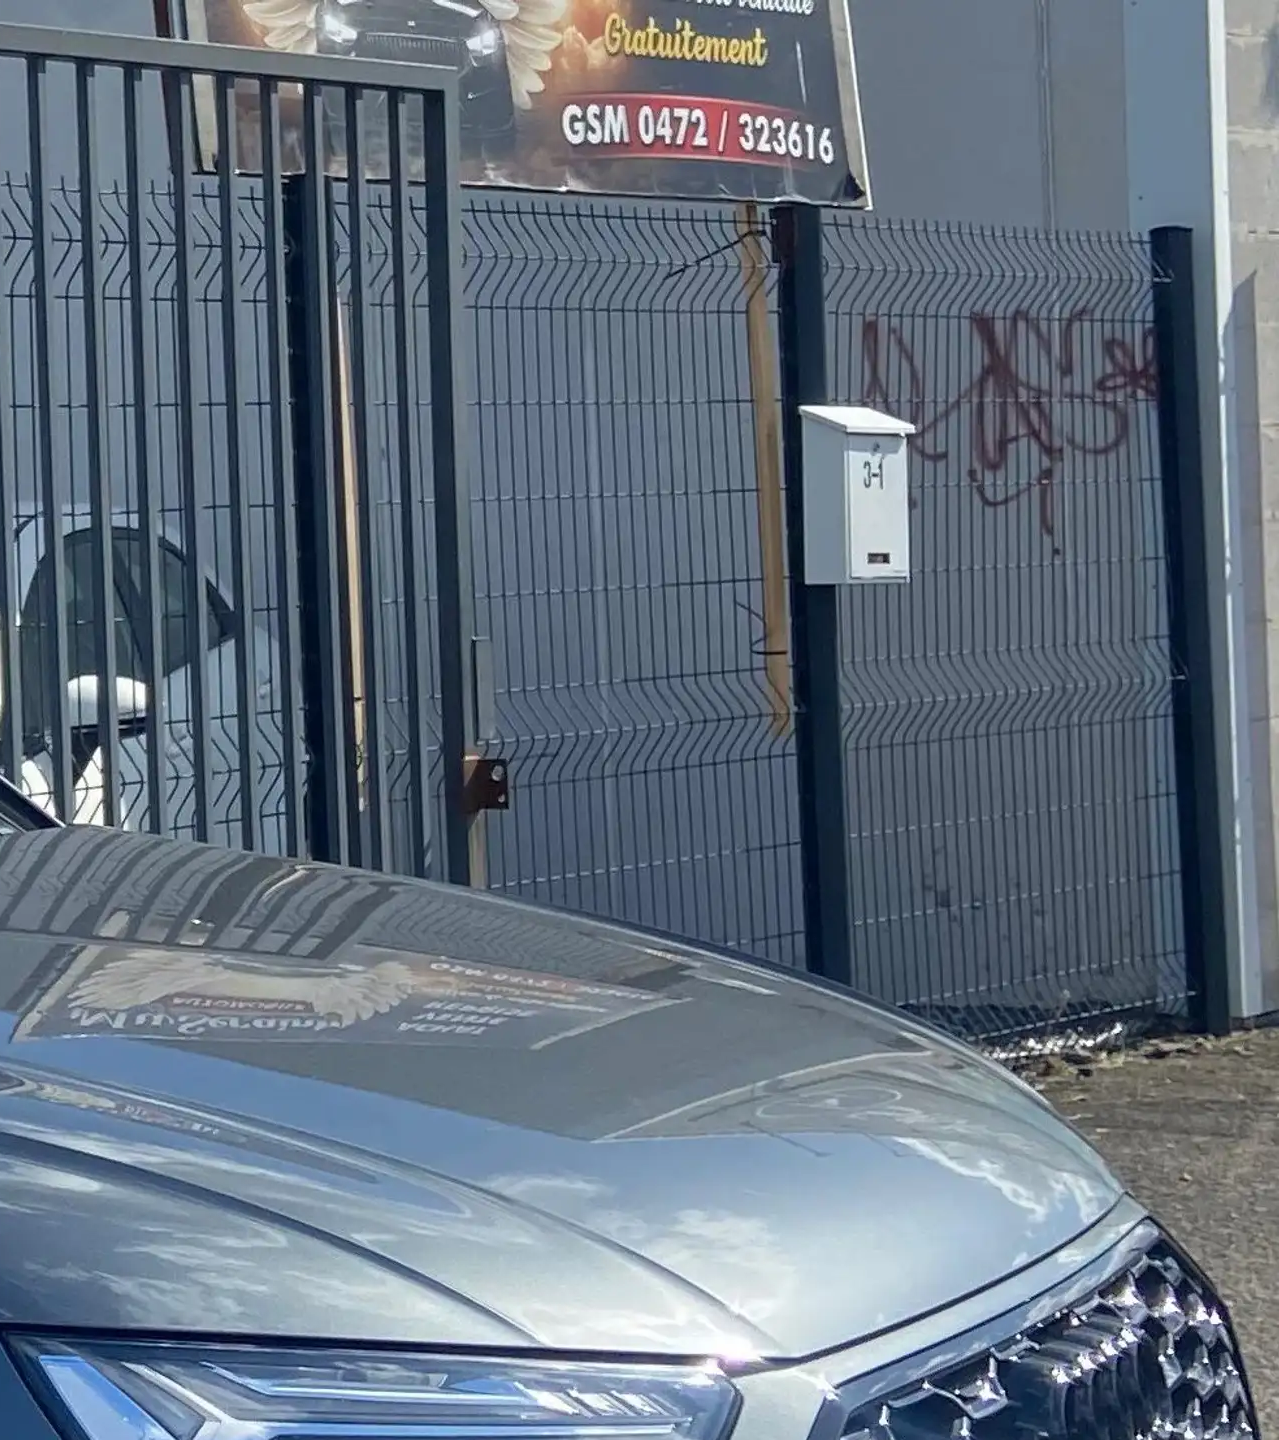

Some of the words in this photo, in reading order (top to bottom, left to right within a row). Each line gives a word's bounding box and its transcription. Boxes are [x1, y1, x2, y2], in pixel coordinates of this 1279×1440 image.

[604, 12, 769, 67] Gratuitement
[561, 103, 631, 146] GSM
[638, 104, 709, 147] 0472
[717, 109, 729, 152] /
[737, 112, 835, 165] 323616
[863, 456, 884, 490] 3-1
